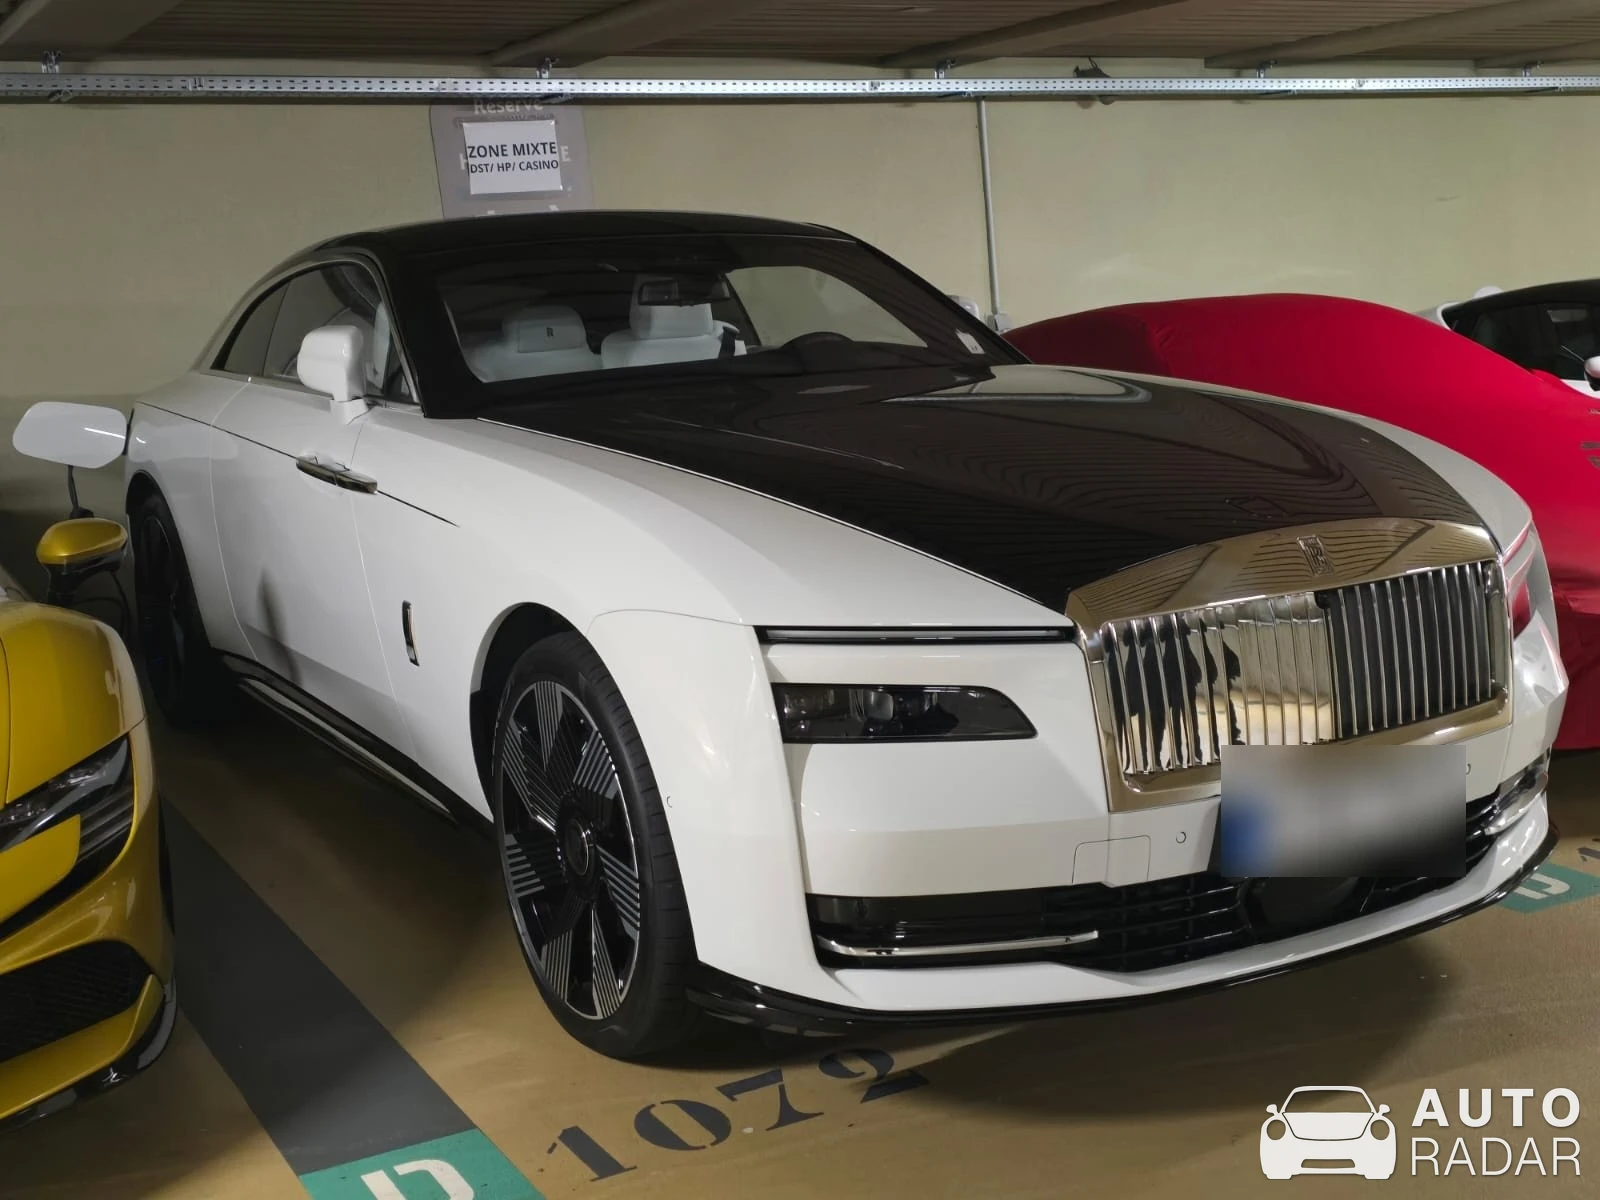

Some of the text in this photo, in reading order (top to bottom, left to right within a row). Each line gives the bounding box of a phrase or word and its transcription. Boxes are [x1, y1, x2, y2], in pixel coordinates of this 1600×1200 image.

[467, 144, 508, 159] ZONE
[513, 141, 557, 157] MIXTE
[470, 159, 559, 174] DST/ HP/ CASINO
[546, 1048, 930, 1182] 1072
